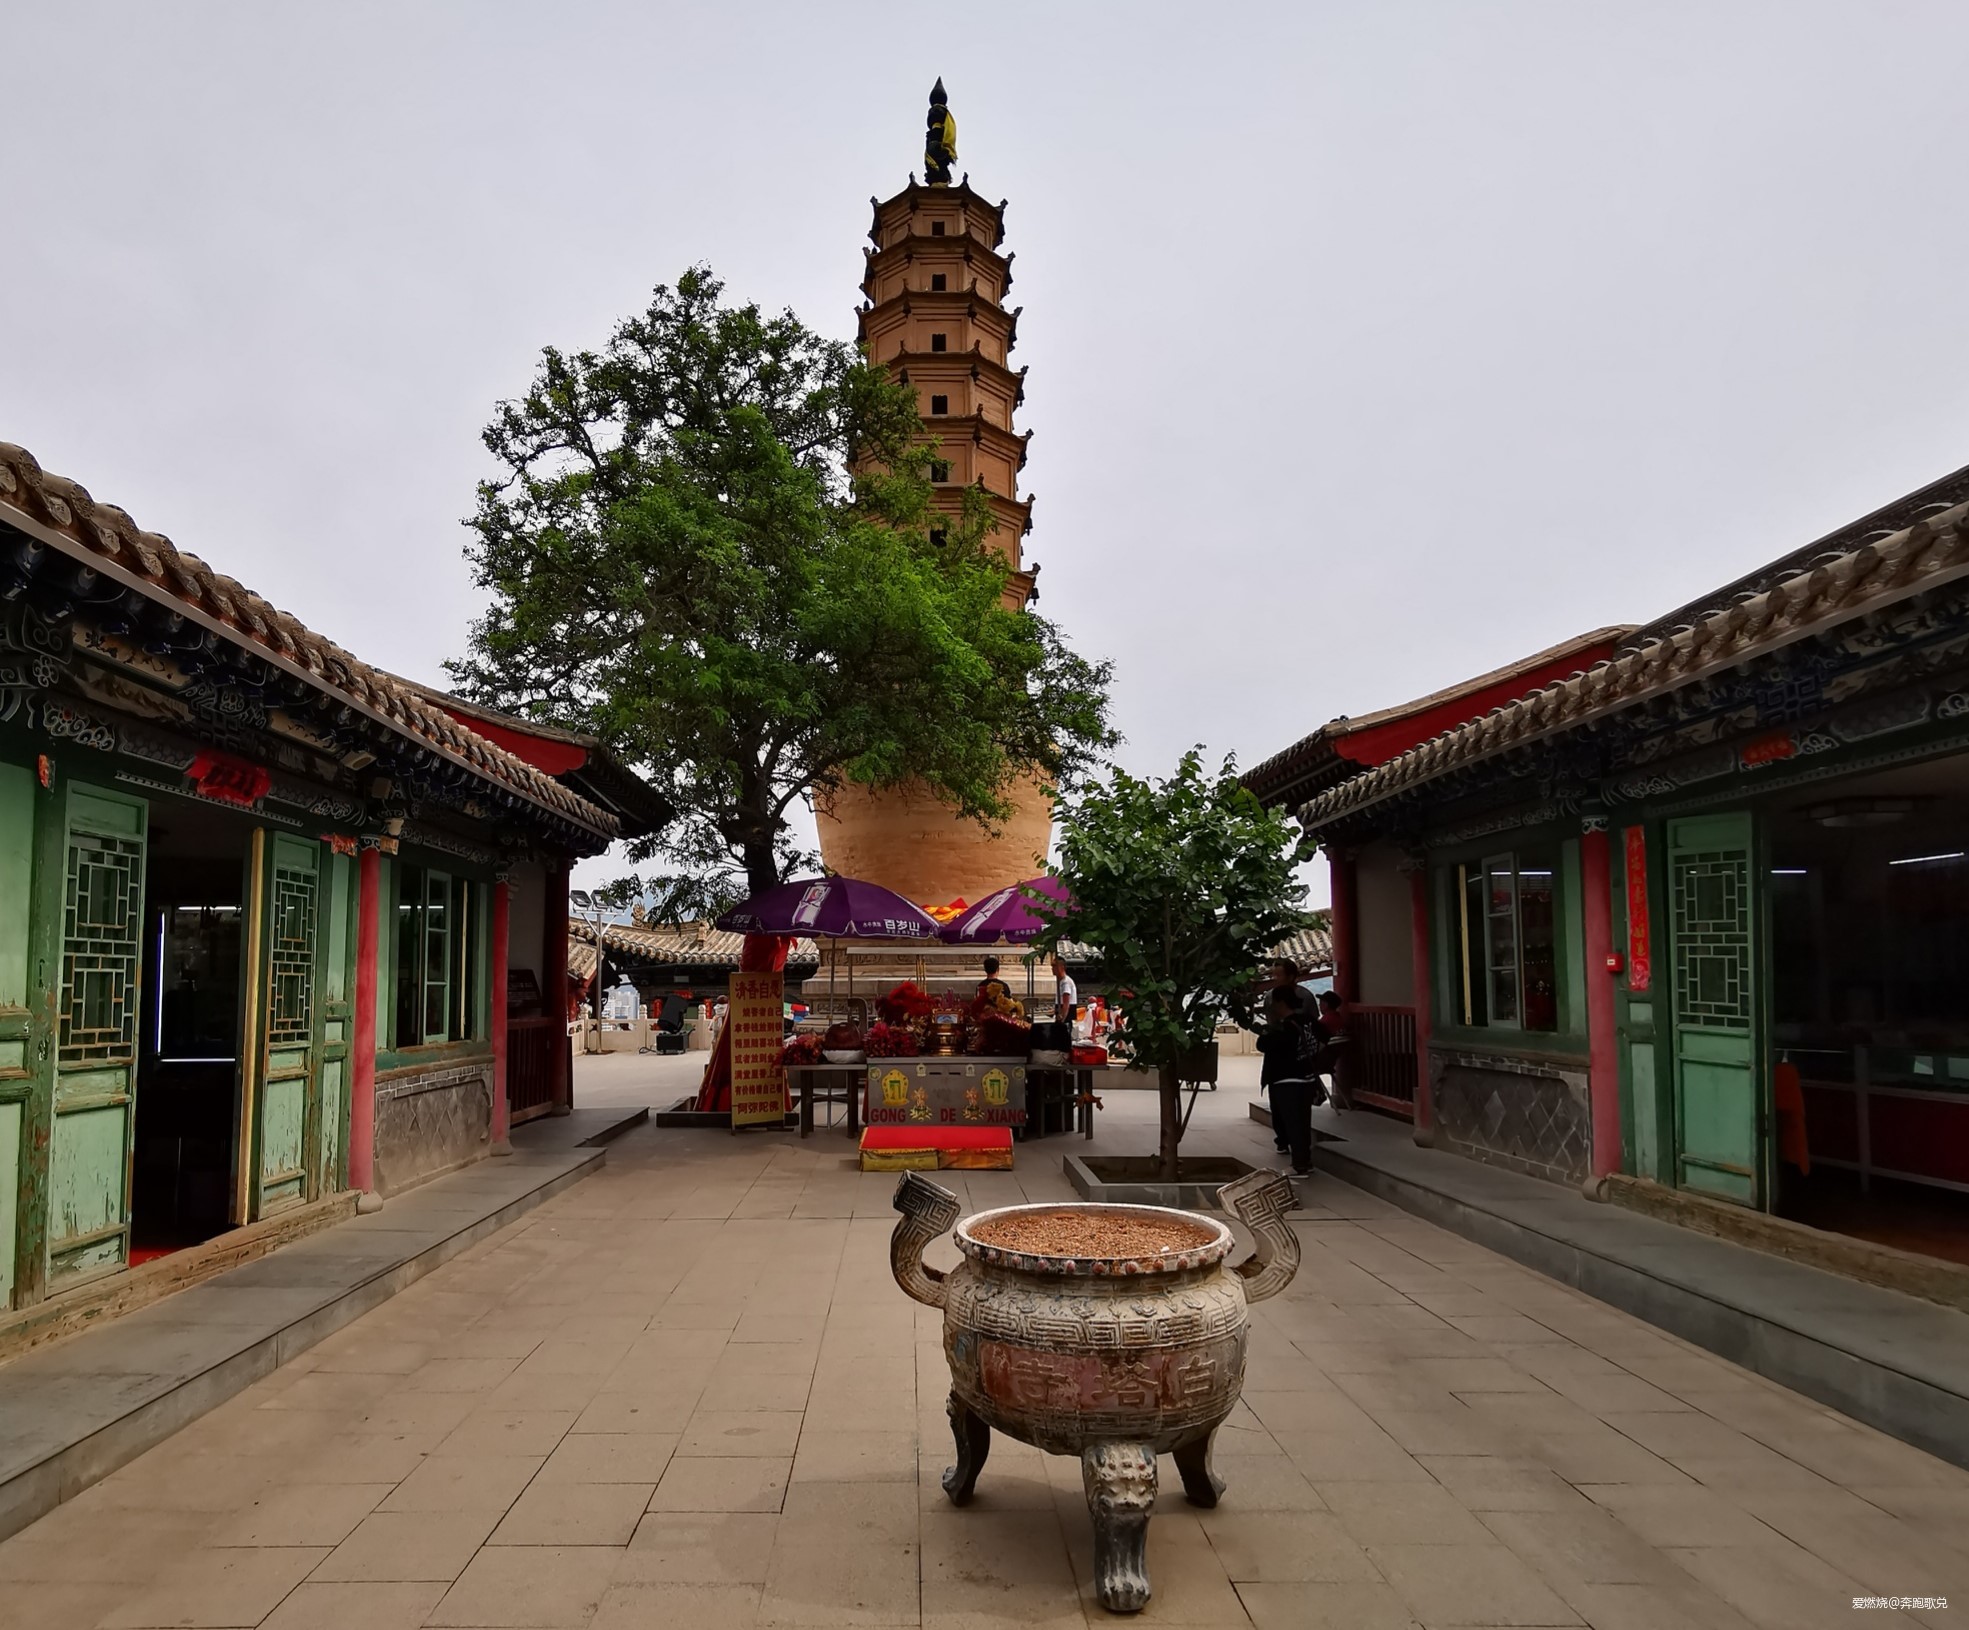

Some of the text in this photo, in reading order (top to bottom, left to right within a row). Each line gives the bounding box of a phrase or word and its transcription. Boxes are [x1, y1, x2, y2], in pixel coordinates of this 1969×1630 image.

[884, 919, 920, 932] 百岁山
[737, 1100, 780, 1114] 阿弥陀佛
[870, 1108, 1026, 1123] GONG DE XIANG
